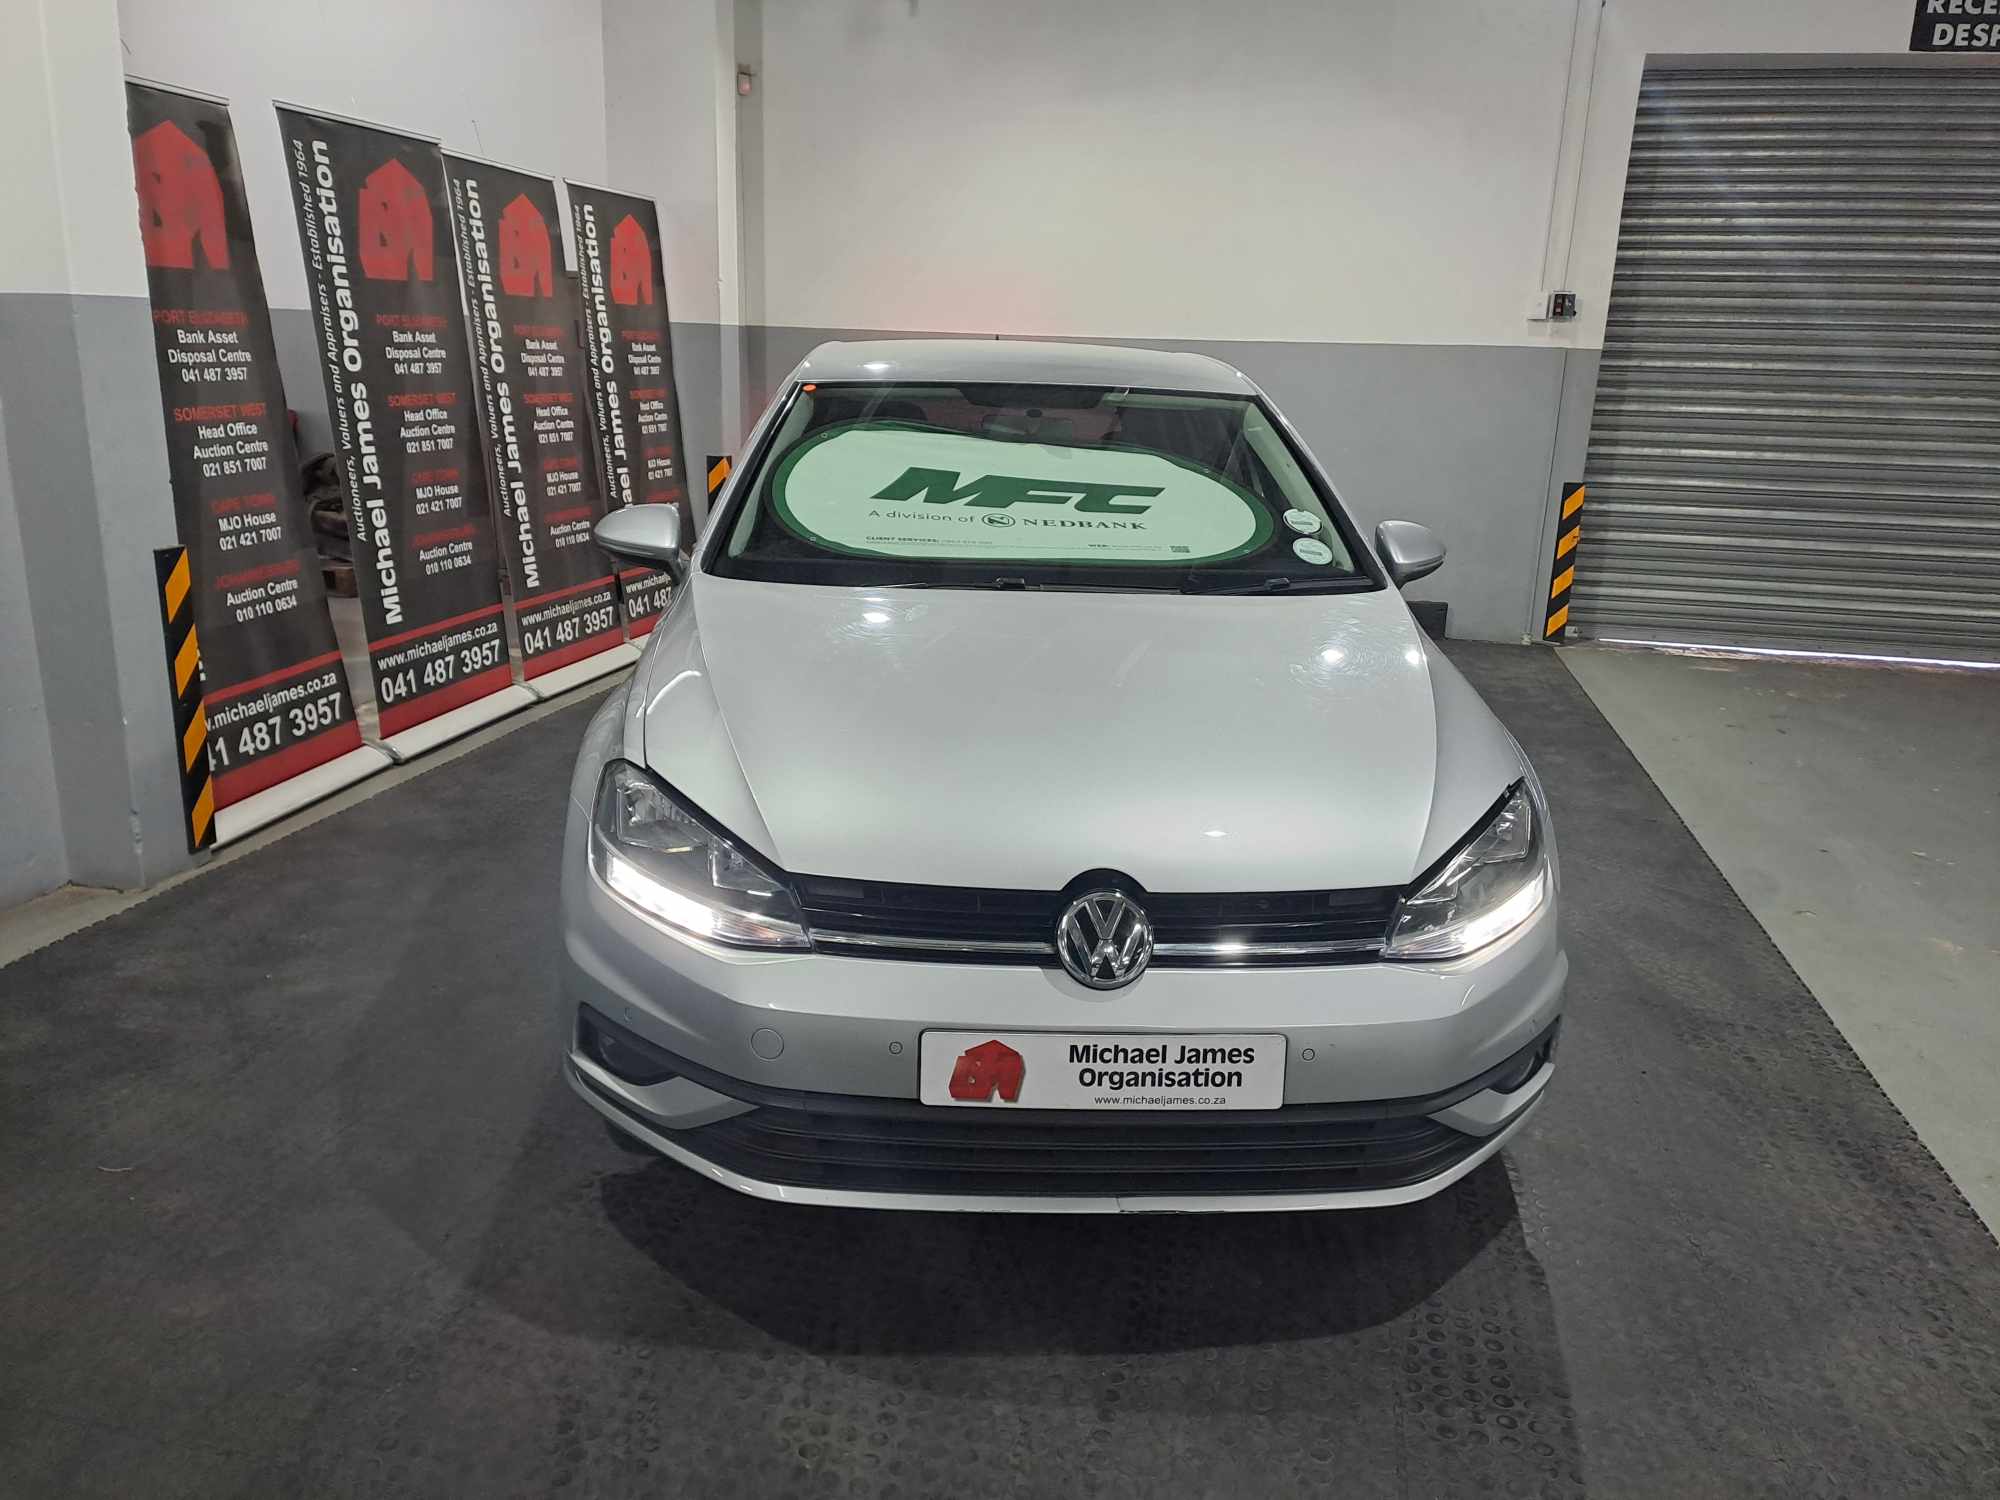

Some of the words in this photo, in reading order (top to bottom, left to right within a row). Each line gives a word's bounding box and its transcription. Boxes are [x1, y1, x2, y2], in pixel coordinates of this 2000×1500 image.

[1927, 0, 2000, 14] RECE
[293, 139, 308, 177] 1964
[300, 181, 323, 270] Established
[311, 140, 362, 372] Organisation
[466, 179, 505, 373] Organisation
[583, 204, 614, 374] Organisation
[317, 282, 339, 361] Appraisers
[177, 329, 206, 344] Bank
[208, 330, 238, 344] Asset
[392, 331, 414, 343] Bank
[415, 331, 436, 343] Asset
[168, 349, 216, 366] Disposal
[219, 349, 251, 362] Centre
[385, 347, 421, 362] Disposal
[422, 347, 447, 359] Centre
[182, 369, 200, 382] 041
[203, 368, 221, 382] 487
[226, 367, 247, 381] 3957
[329, 363, 342, 393] and
[394, 363, 408, 375] 041
[410, 363, 424, 374] 487
[426, 362, 442, 374] 3957
[335, 397, 352, 450] Valuers
[404, 410, 424, 422] Head
[426, 408, 448, 421] Office
[606, 380, 627, 461] James
[198, 424, 224, 439] Head
[227, 422, 257, 435] Office
[351, 382, 382, 490] James
[400, 425, 430, 439] Auction
[431, 424, 456, 436] Centre
[497, 382, 522, 474] James
[193, 443, 234, 459] Auction
[236, 440, 269, 454] Centre
[406, 441, 420, 453] 021
[421, 440, 436, 452] 851
[203, 463, 222, 477] 021
[224, 460, 242, 474] 851
[245, 457, 267, 471] 7007
[346, 455, 368, 542] Auctioneers,
[416, 486, 433, 499] MJO
[434, 484, 459, 496] House
[869, 466, 1166, 515] MFC
[416, 503, 429, 515] 021
[431, 500, 444, 513] 421
[446, 497, 462, 509] 7007
[218, 515, 241, 532] MJO
[243, 512, 277, 527] House
[869, 510, 880, 518] A
[886, 511, 952, 522] division
[958, 515, 975, 523] of
[1023, 518, 1148, 530] NEDBANK
[219, 537, 237, 551] 021
[239, 532, 257, 546] 421
[260, 527, 282, 542] 7007
[510, 481, 540, 588] Michael
[366, 499, 403, 625] Michael
[419, 546, 447, 561] Auction
[448, 541, 473, 554] Centre
[426, 563, 439, 576] 010
[440, 560, 453, 572] 110
[226, 587, 266, 606] Auction
[267, 578, 299, 596] Centre
[236, 608, 254, 622] 010
[255, 601, 273, 616] 110
[275, 594, 297, 612] 0634
[521, 590, 611, 626] www.michaeljames.co.za
[629, 594, 650, 617] 041
[524, 627, 551, 654] 041
[556, 617, 579, 643] 487
[584, 606, 613, 634] 3957
[377, 622, 498, 671] www.michaeljames.co.za
[381, 669, 416, 703] 041
[424, 655, 455, 686] 487
[461, 639, 500, 673] 3957
[207, 736, 230, 771] 41
[238, 715, 282, 756] 487
[289, 692, 342, 737] 3957
[1068, 1043, 1168, 1065] Michael
[1174, 1044, 1256, 1065] James
[1078, 1067, 1243, 1090] Organisation
[1094, 1095, 1227, 1107] www.michaeljames.co.za
